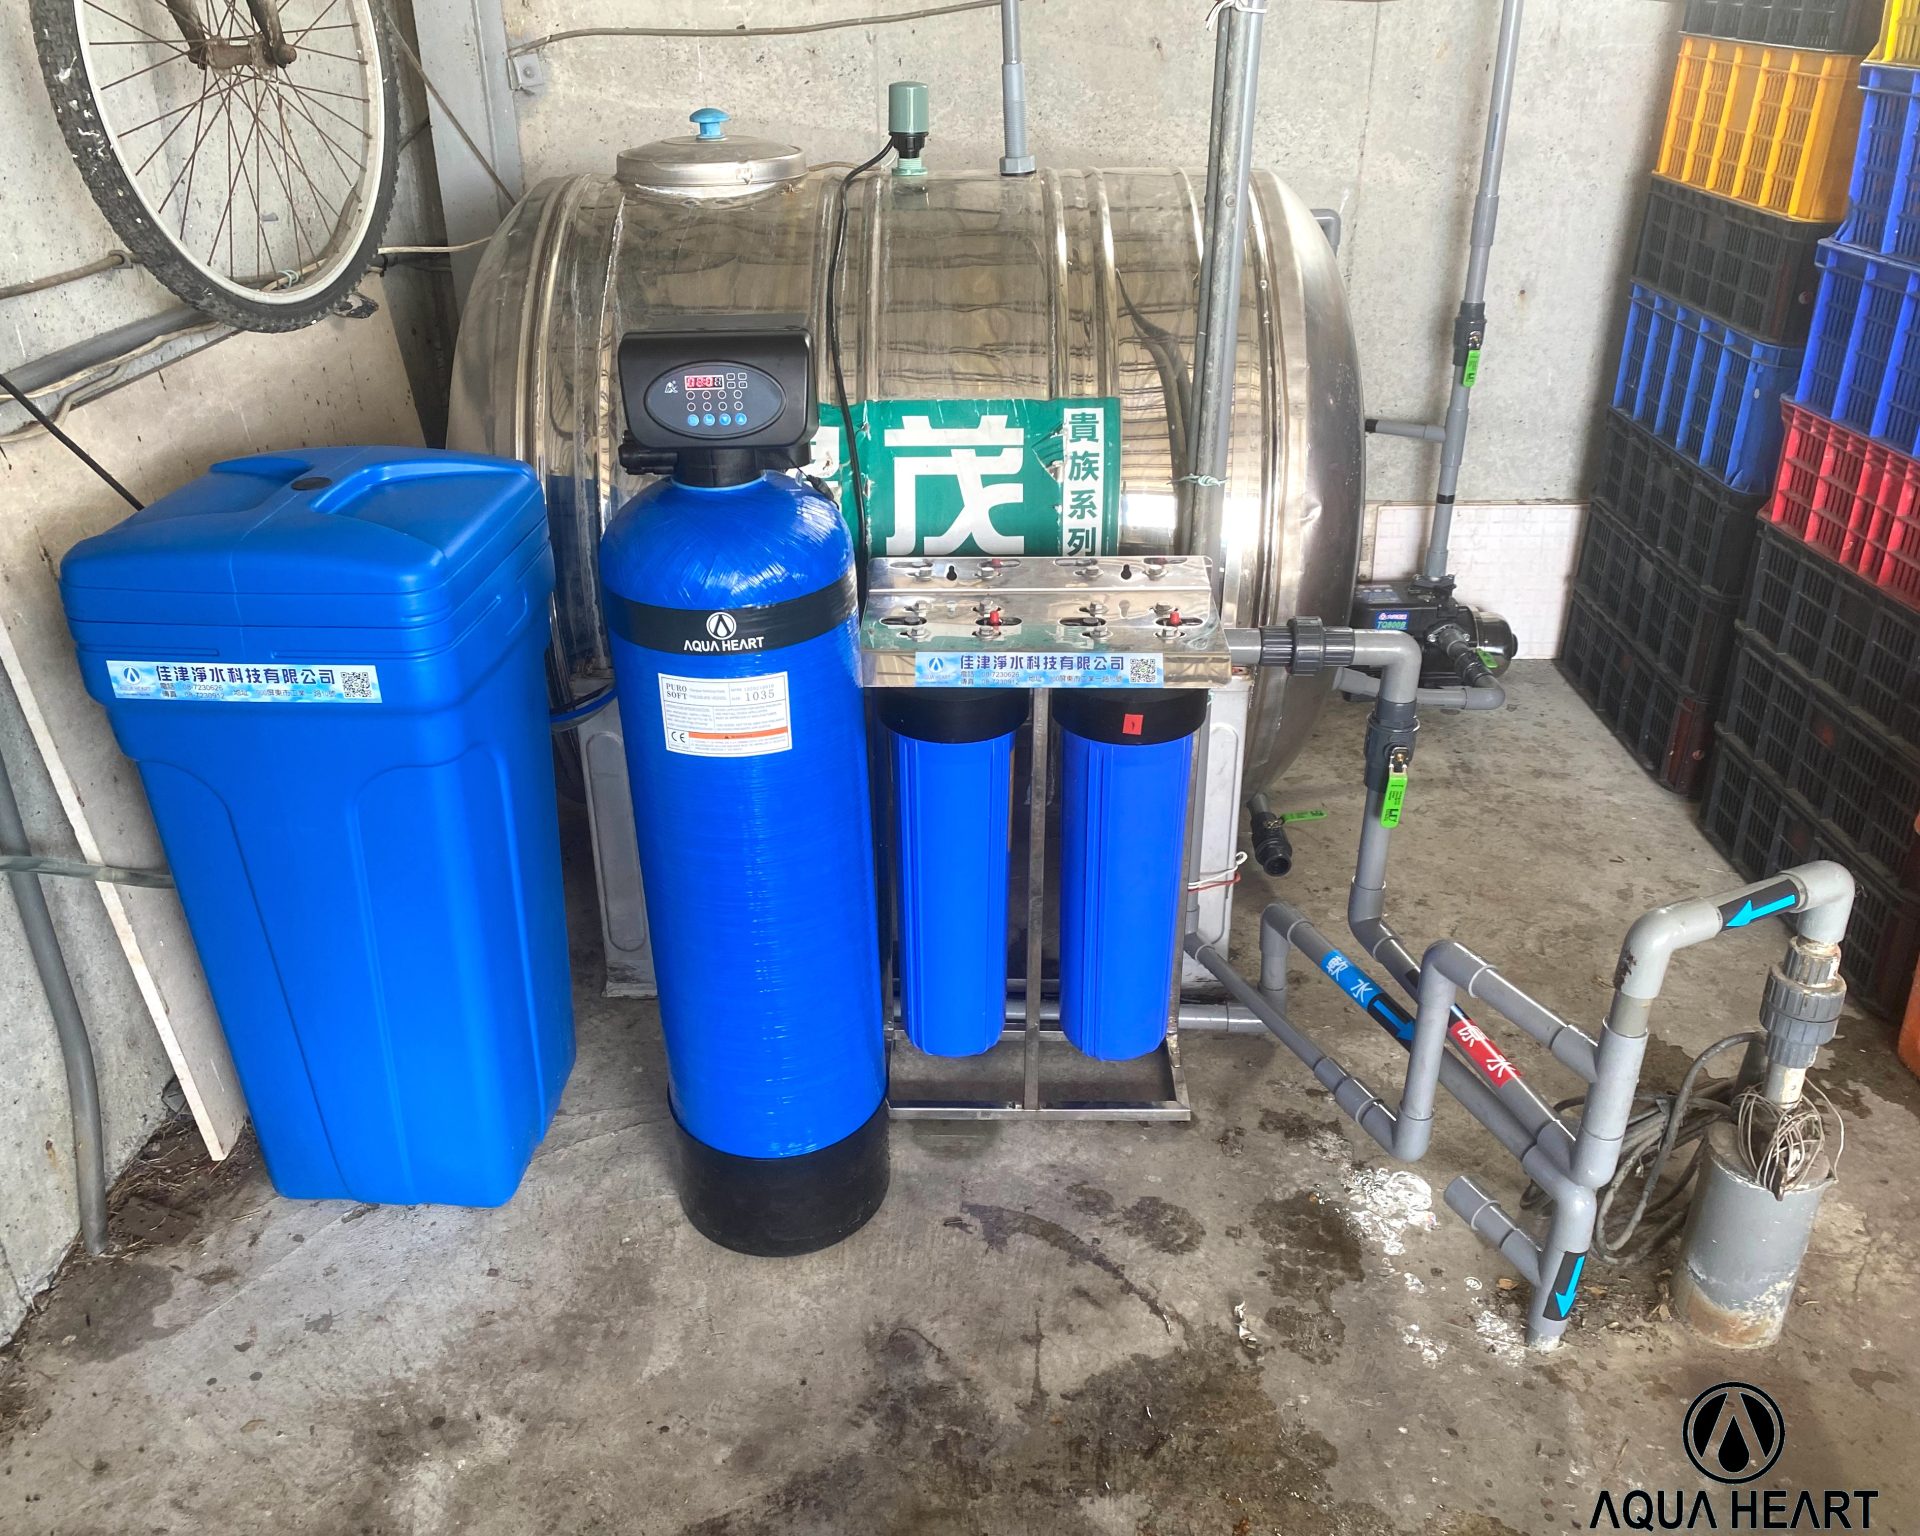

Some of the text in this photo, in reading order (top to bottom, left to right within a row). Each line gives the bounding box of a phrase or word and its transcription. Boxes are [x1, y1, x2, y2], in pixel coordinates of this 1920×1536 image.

[1067, 411, 1100, 557] 貴族系列
[683, 636, 765, 653] AQUA HEART
[959, 655, 1125, 671] 佳津淨水科技有限公司
[155, 665, 336, 685] 佳津淨水科技有限公司
[666, 682, 688, 693] PURO
[666, 690, 688, 700] SOFT
[745, 688, 775, 702] 1035
[1457, 1024, 1517, 1078] 原水
